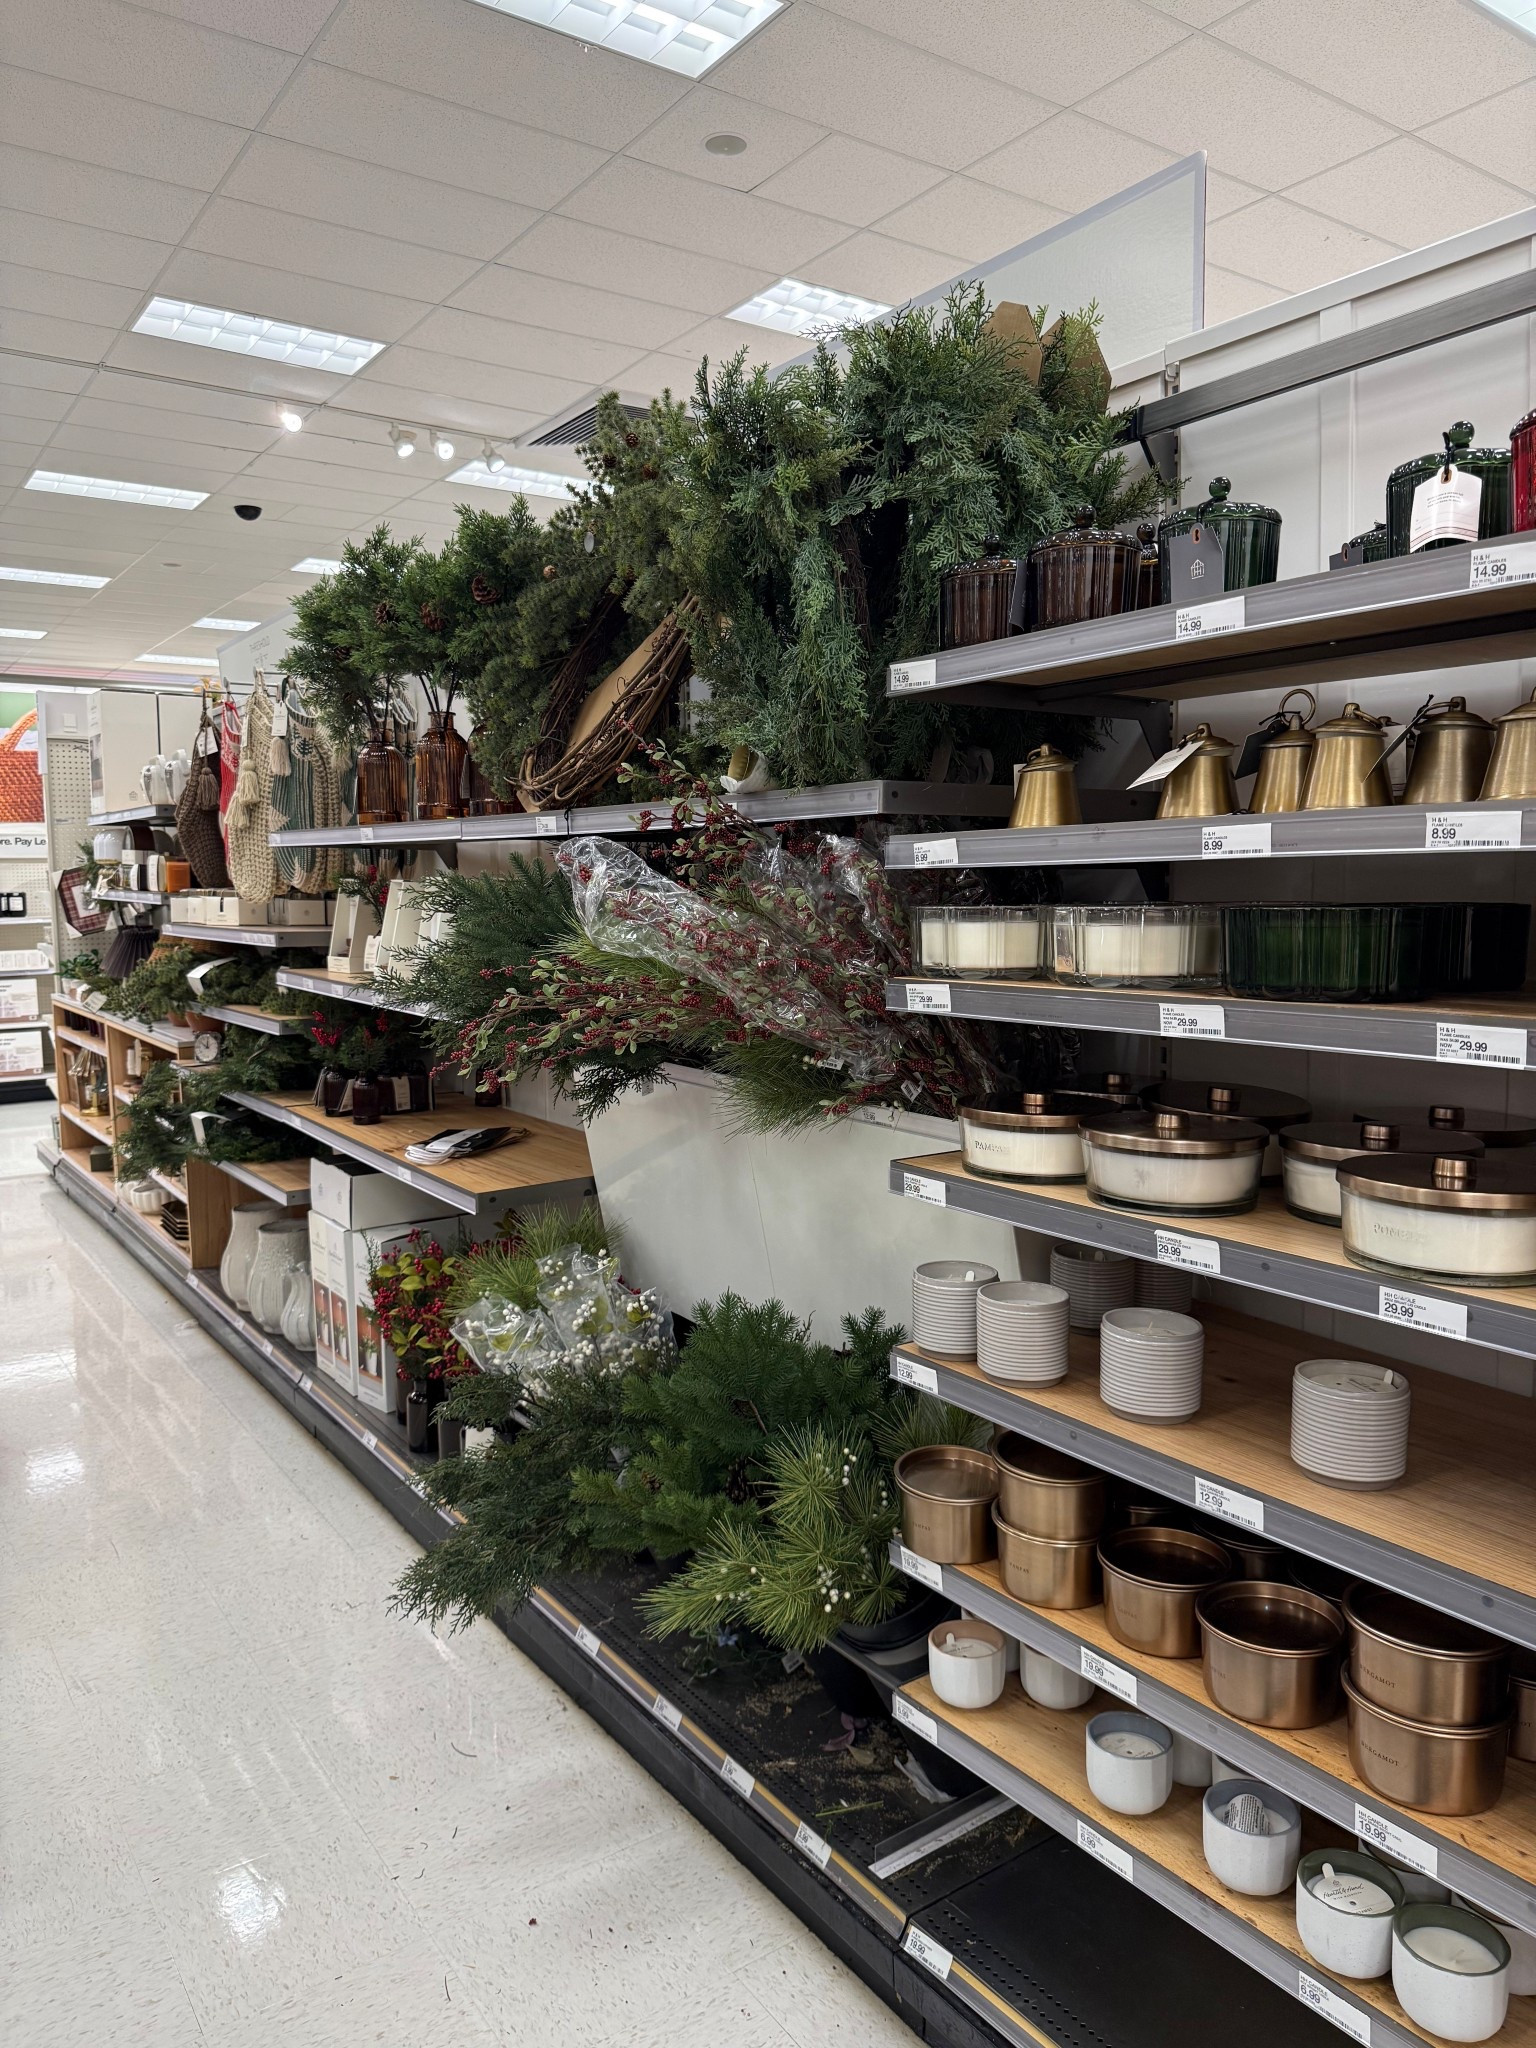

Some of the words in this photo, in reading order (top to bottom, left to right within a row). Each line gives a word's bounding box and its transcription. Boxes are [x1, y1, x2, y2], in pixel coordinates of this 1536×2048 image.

[1474, 564, 1506, 578] 14.99
[1178, 620, 1201, 633] 14.99
[894, 675, 909, 684] 14.99
[1432, 828, 1456, 839] 8.99
[15, 837, 32, 847] Pay
[1204, 840, 1223, 850] 8.99
[916, 853, 928, 862] 8.99
[919, 995, 932, 1003] 29.99
[1177, 1018, 1197, 1027] 29.99
[1459, 1040, 1487, 1052] 29.99
[905, 1183, 920, 1193] 29.99
[1159, 1244, 1181, 1256] 29.99
[1384, 1302, 1414, 1318] 29.99
[898, 1368, 912, 1380] 12.99
[1200, 1491, 1223, 1507] 12.99
[1085, 1660, 1104, 1676] 19.99
[898, 1706, 909, 1719] 6.99
[1361, 1740, 1399, 1766] BERGAMOT
[1360, 1820, 1386, 1842] 19.99
[1080, 1832, 1096, 1848] 6.99
[910, 1939, 926, 1955] 19.99
[1301, 1985, 1320, 2003] 6.99
